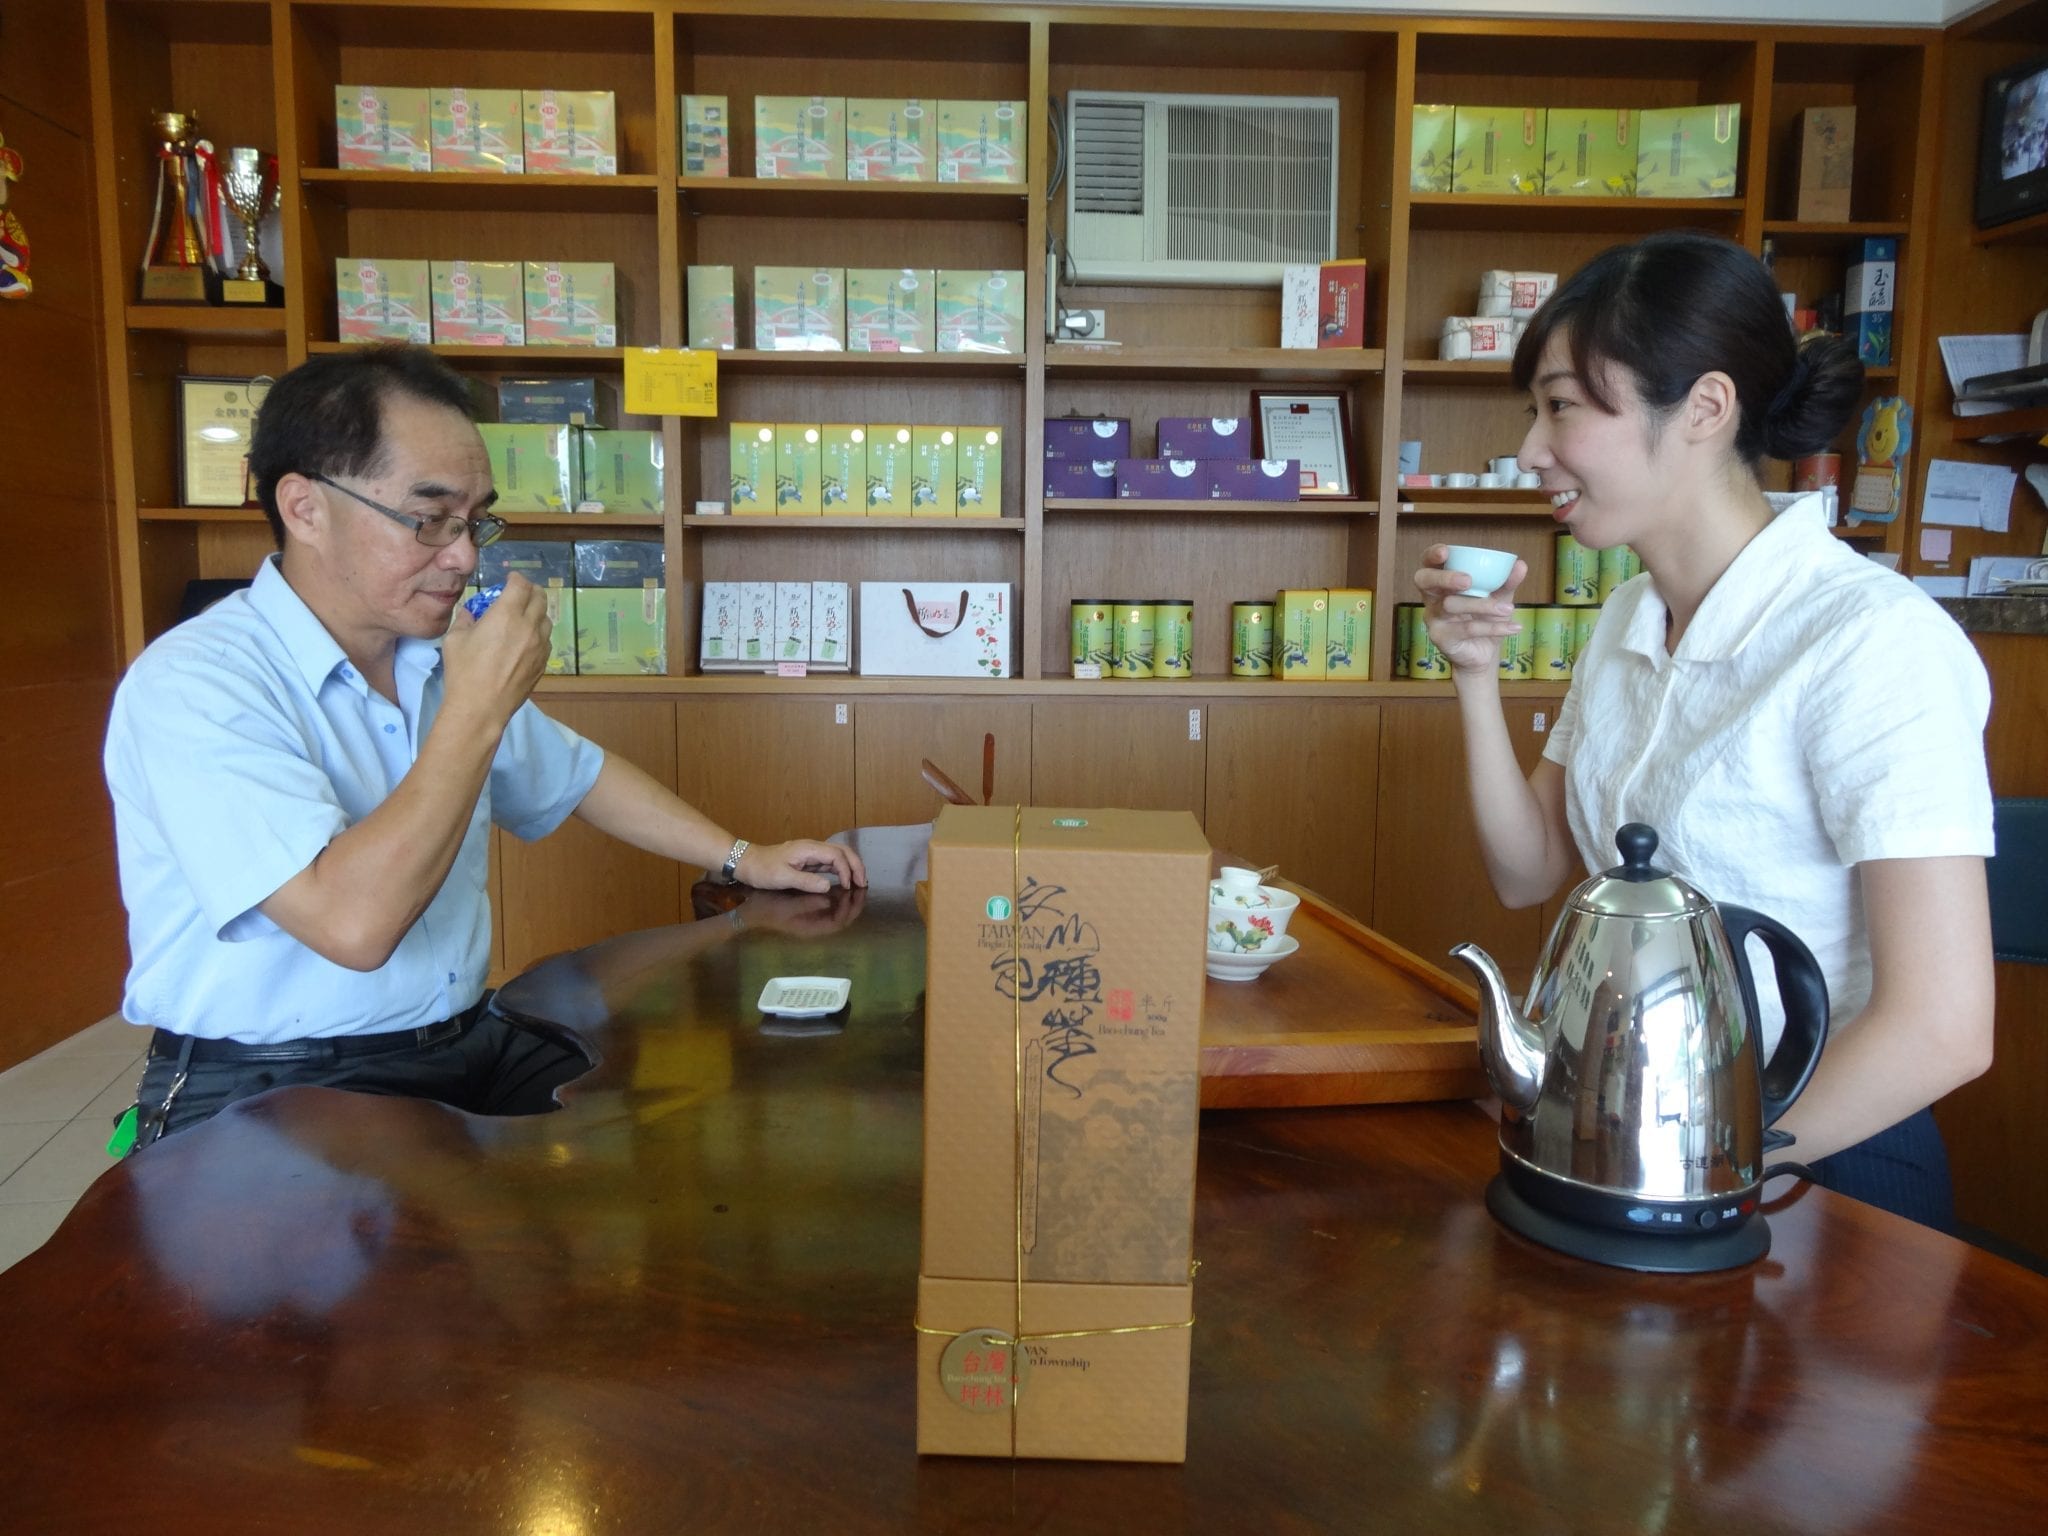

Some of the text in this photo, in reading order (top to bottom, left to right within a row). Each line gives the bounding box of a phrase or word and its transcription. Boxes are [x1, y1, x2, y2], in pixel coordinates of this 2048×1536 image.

[978, 924, 1046, 940] TAIWAN
[962, 1350, 1008, 1375] 台灣
[960, 1384, 1004, 1408] 坪林
